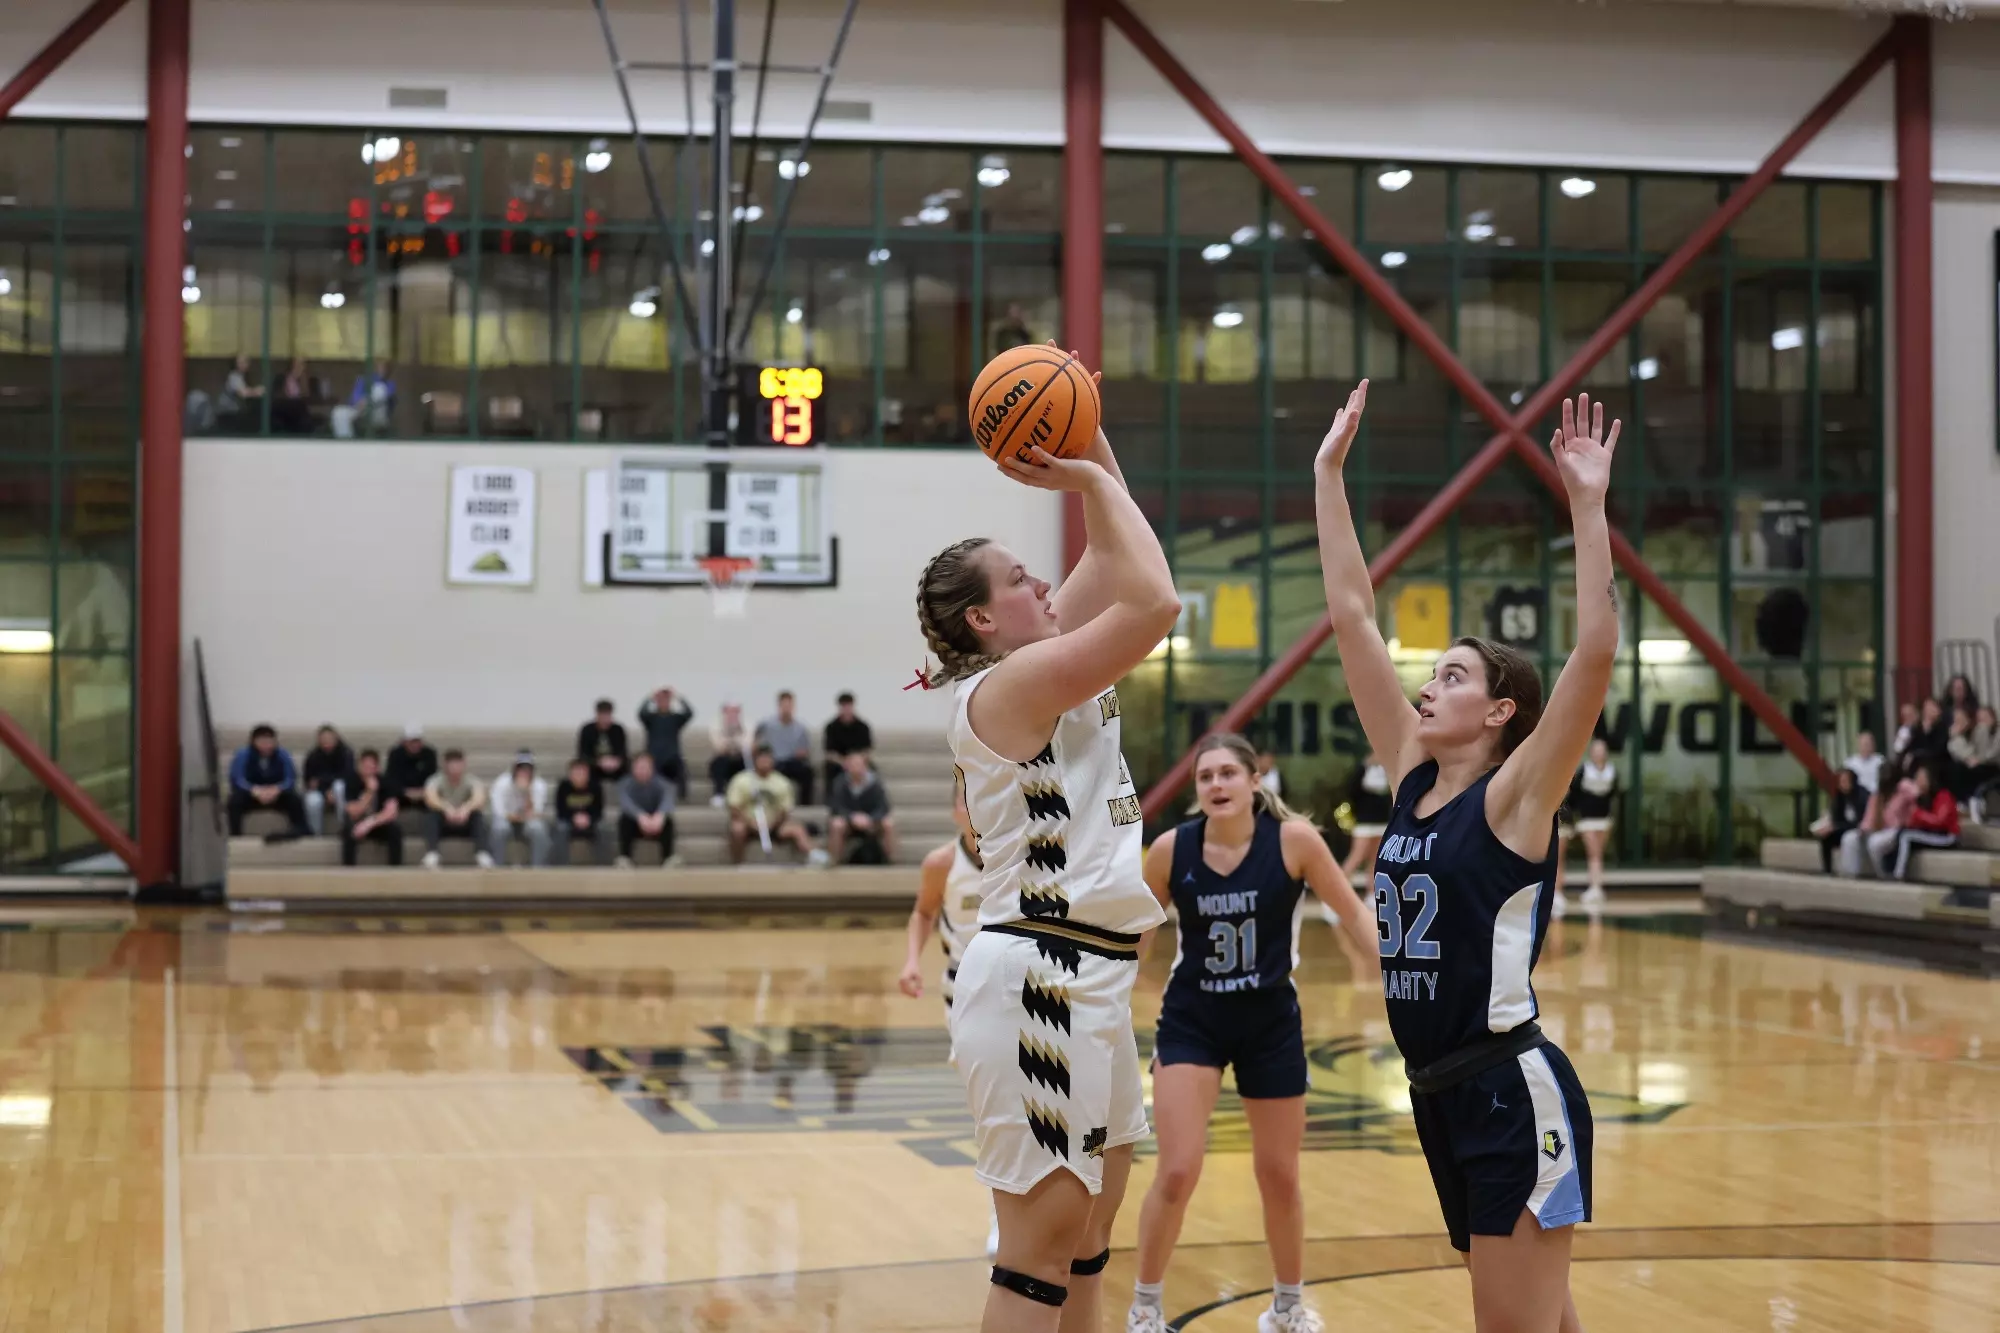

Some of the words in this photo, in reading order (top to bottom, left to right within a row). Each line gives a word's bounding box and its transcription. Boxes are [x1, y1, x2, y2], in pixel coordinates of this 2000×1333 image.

[771, 397, 812, 445] 13
[976, 378, 1034, 449] Wilson
[1042, 400, 1054, 419] NXT
[1501, 604, 1537, 641] 69
[1175, 701, 1374, 756] THIS
[1378, 832, 1439, 864] MOUNT
[1196, 890, 1259, 917] MOUNT
[1374, 871, 1441, 960] 32
[1204, 917, 1257, 975] 31
